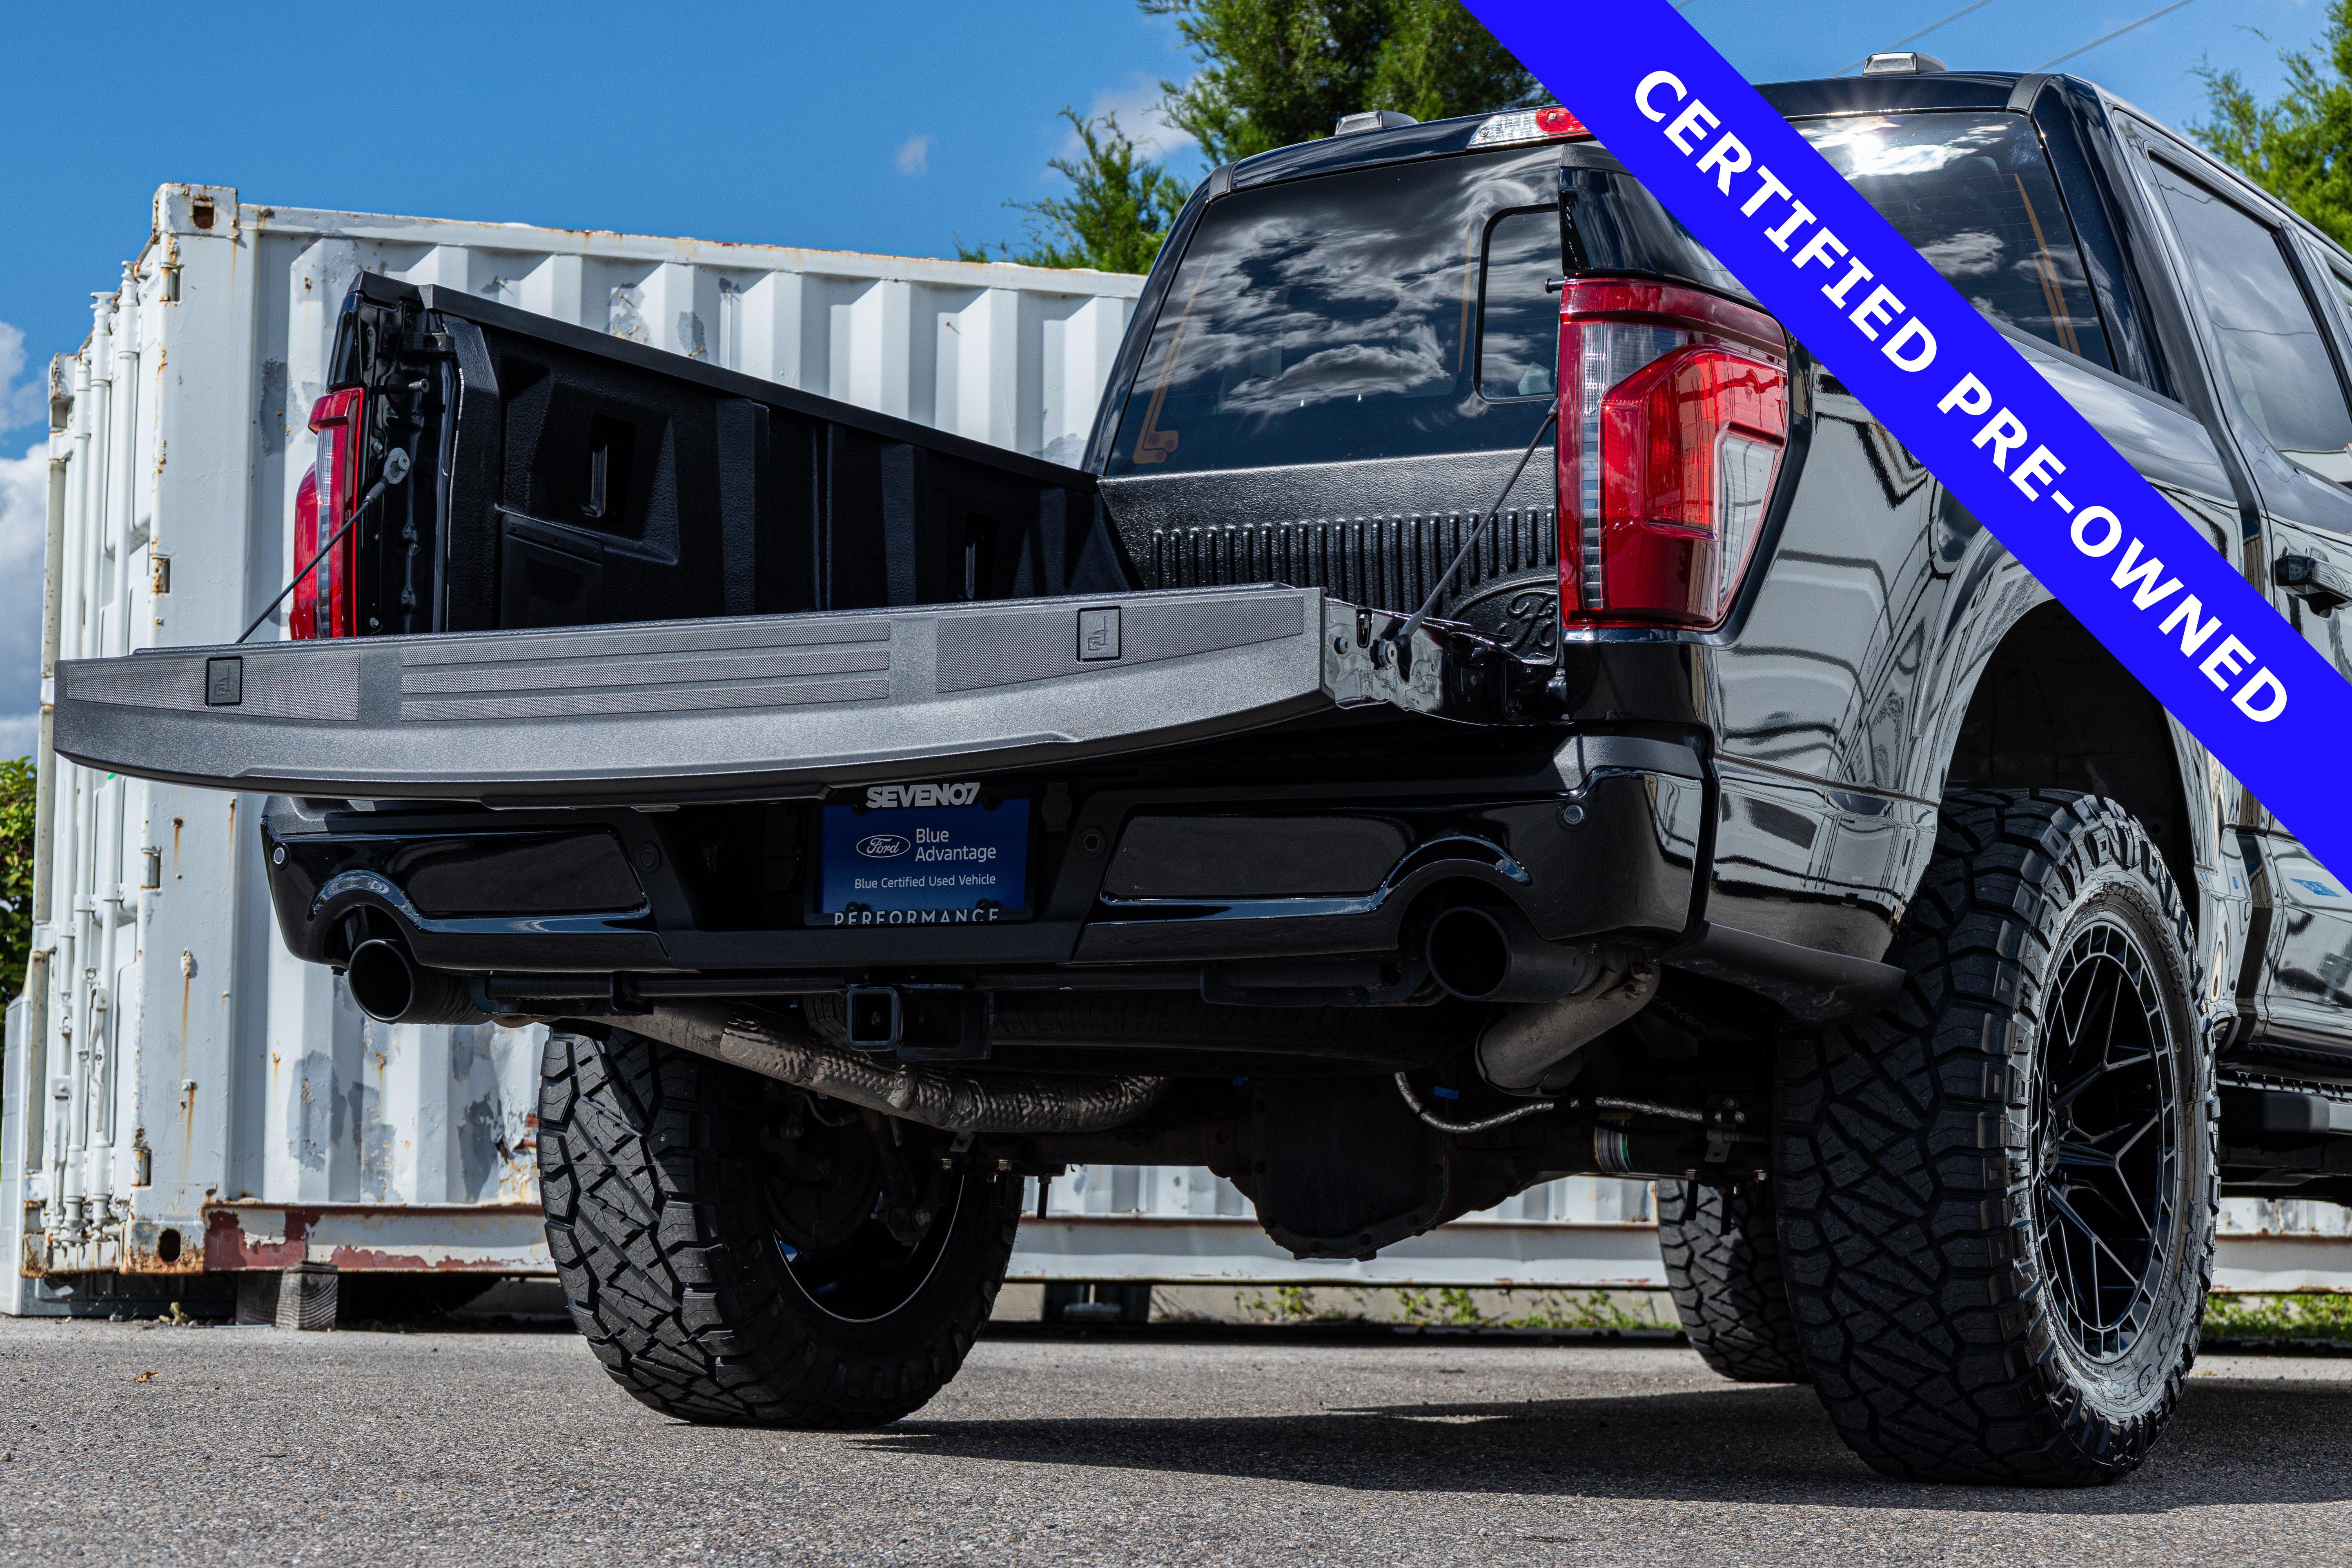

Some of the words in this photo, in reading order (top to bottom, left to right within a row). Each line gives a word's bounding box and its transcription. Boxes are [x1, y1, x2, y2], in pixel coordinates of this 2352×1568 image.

[916, 828, 949, 843] Blue
[866, 837, 900, 854] Ford
[915, 846, 996, 862] Advantage
[855, 878, 878, 889] Blue
[881, 876, 925, 888] Certified
[929, 875, 955, 886] Used
[959, 874, 996, 885] Vehicle
[834, 909, 999, 925] PERFORMANCE
